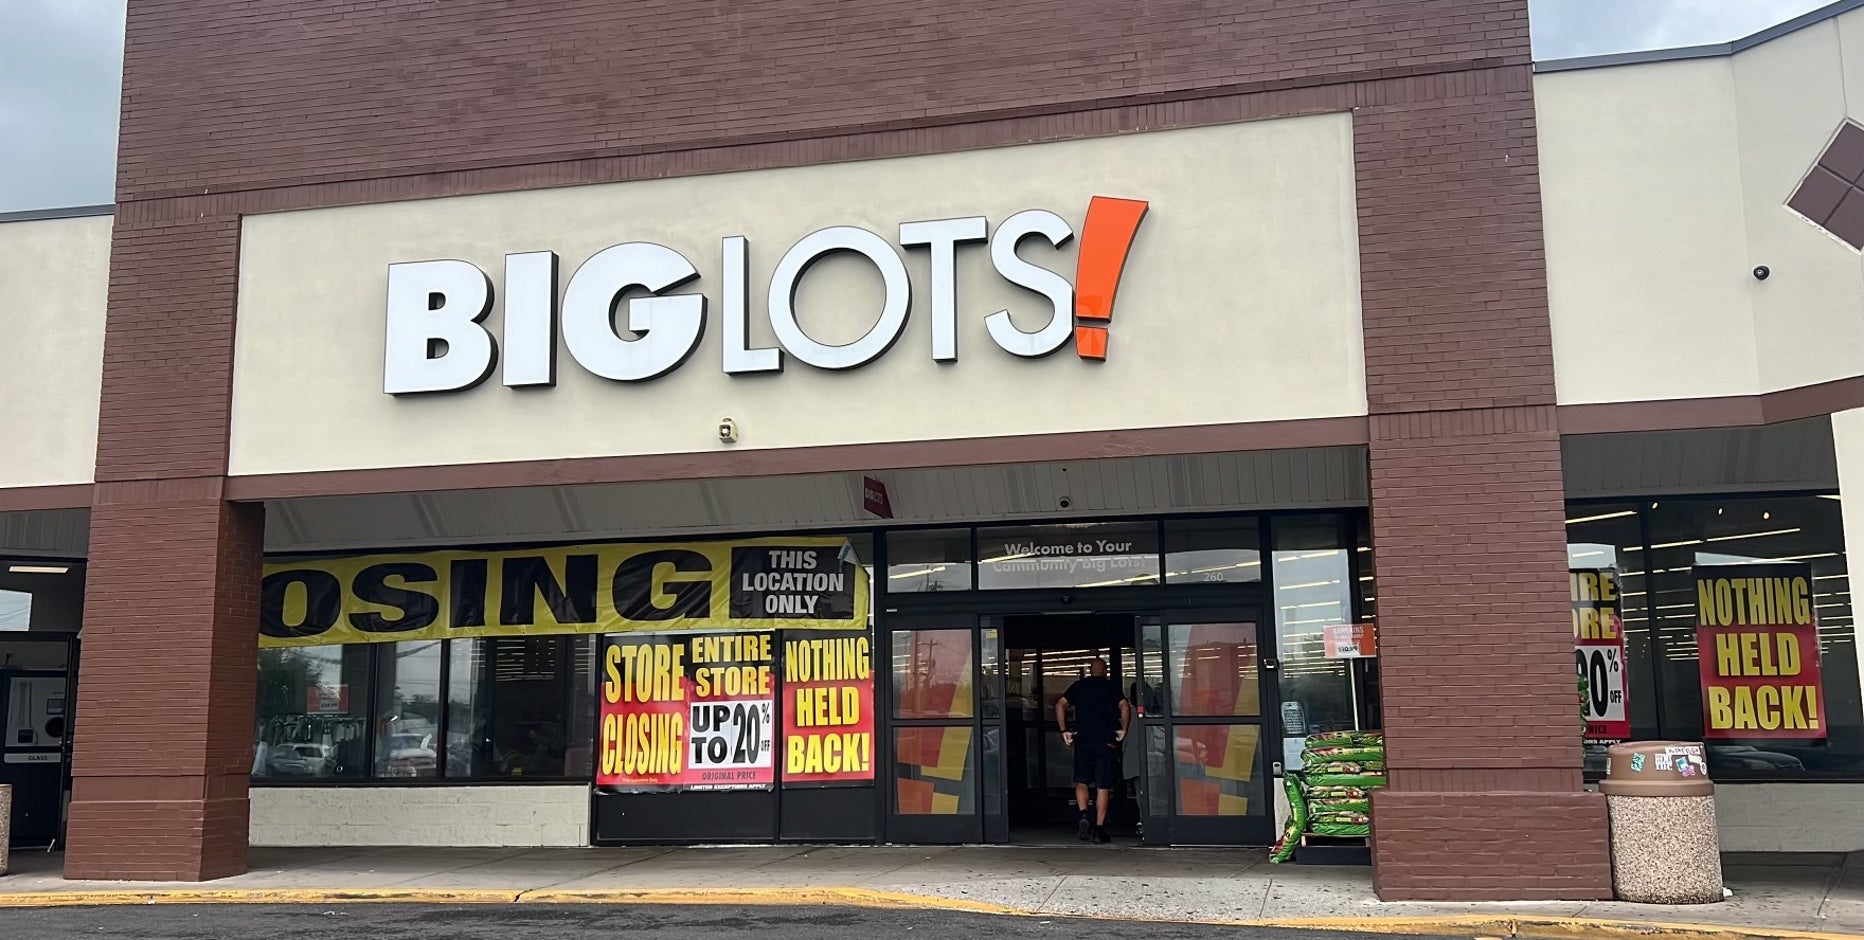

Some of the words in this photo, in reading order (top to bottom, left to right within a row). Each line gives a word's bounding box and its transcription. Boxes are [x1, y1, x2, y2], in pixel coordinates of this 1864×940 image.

[768, 550, 817, 569] THIS
[1004, 542, 1073, 555] Welcome
[1077, 542, 1092, 553] to
[1096, 540, 1132, 552] Your
[993, 557, 1077, 573] Community
[1203, 572, 1224, 582] 260
[260, 549, 713, 638] OSING
[742, 572, 844, 592] LOCATION
[765, 594, 819, 614] ONLY
[1697, 576, 1811, 626] NOTHING
[692, 634, 772, 664] ENTIRE
[785, 636, 869, 682] NOTHING
[1716, 632, 1801, 676] HELD
[605, 643, 685, 704] STORE
[695, 665, 771, 697] STORE
[796, 686, 860, 726] HELD
[1610, 690, 1622, 704] OFF
[1708, 685, 1820, 730] BACK!
[692, 705, 730, 732] UP
[602, 711, 684, 775] CLOSING
[691, 736, 728, 764] TO
[761, 740, 771, 752] OFF
[787, 732, 870, 774] BACK!
[701, 772, 734, 780] ORIGINAL
[737, 771, 756, 779] PRICE
